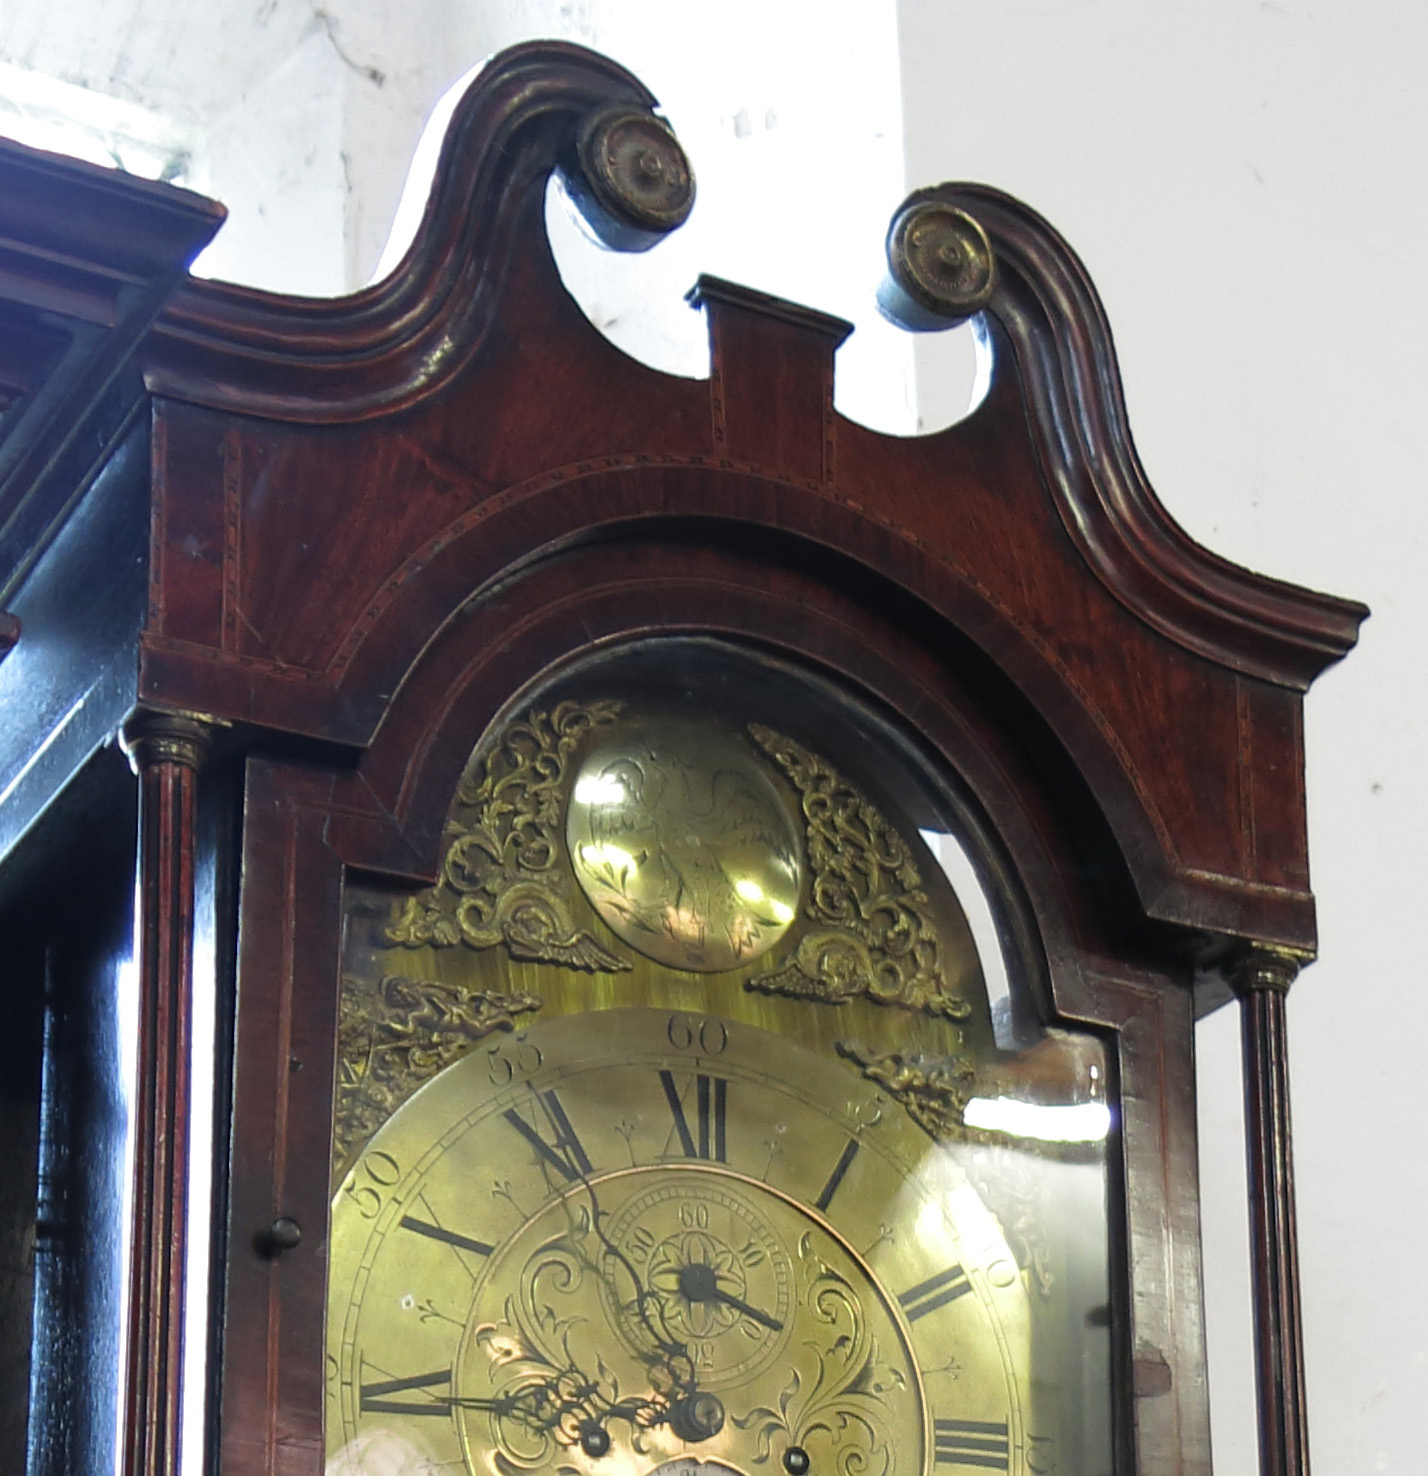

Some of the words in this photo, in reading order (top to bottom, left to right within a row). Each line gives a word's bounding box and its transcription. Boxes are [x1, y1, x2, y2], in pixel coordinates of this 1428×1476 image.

[487, 1031, 544, 1087] 55
[667, 1013, 729, 1056] 60
[656, 1069, 736, 1166] XII
[345, 1149, 401, 1220] 50
[394, 1182, 500, 1289] X
[679, 1202, 708, 1229] 60
[626, 1226, 655, 1264] 50
[740, 1238, 765, 1268] 10
[892, 1261, 978, 1334] II
